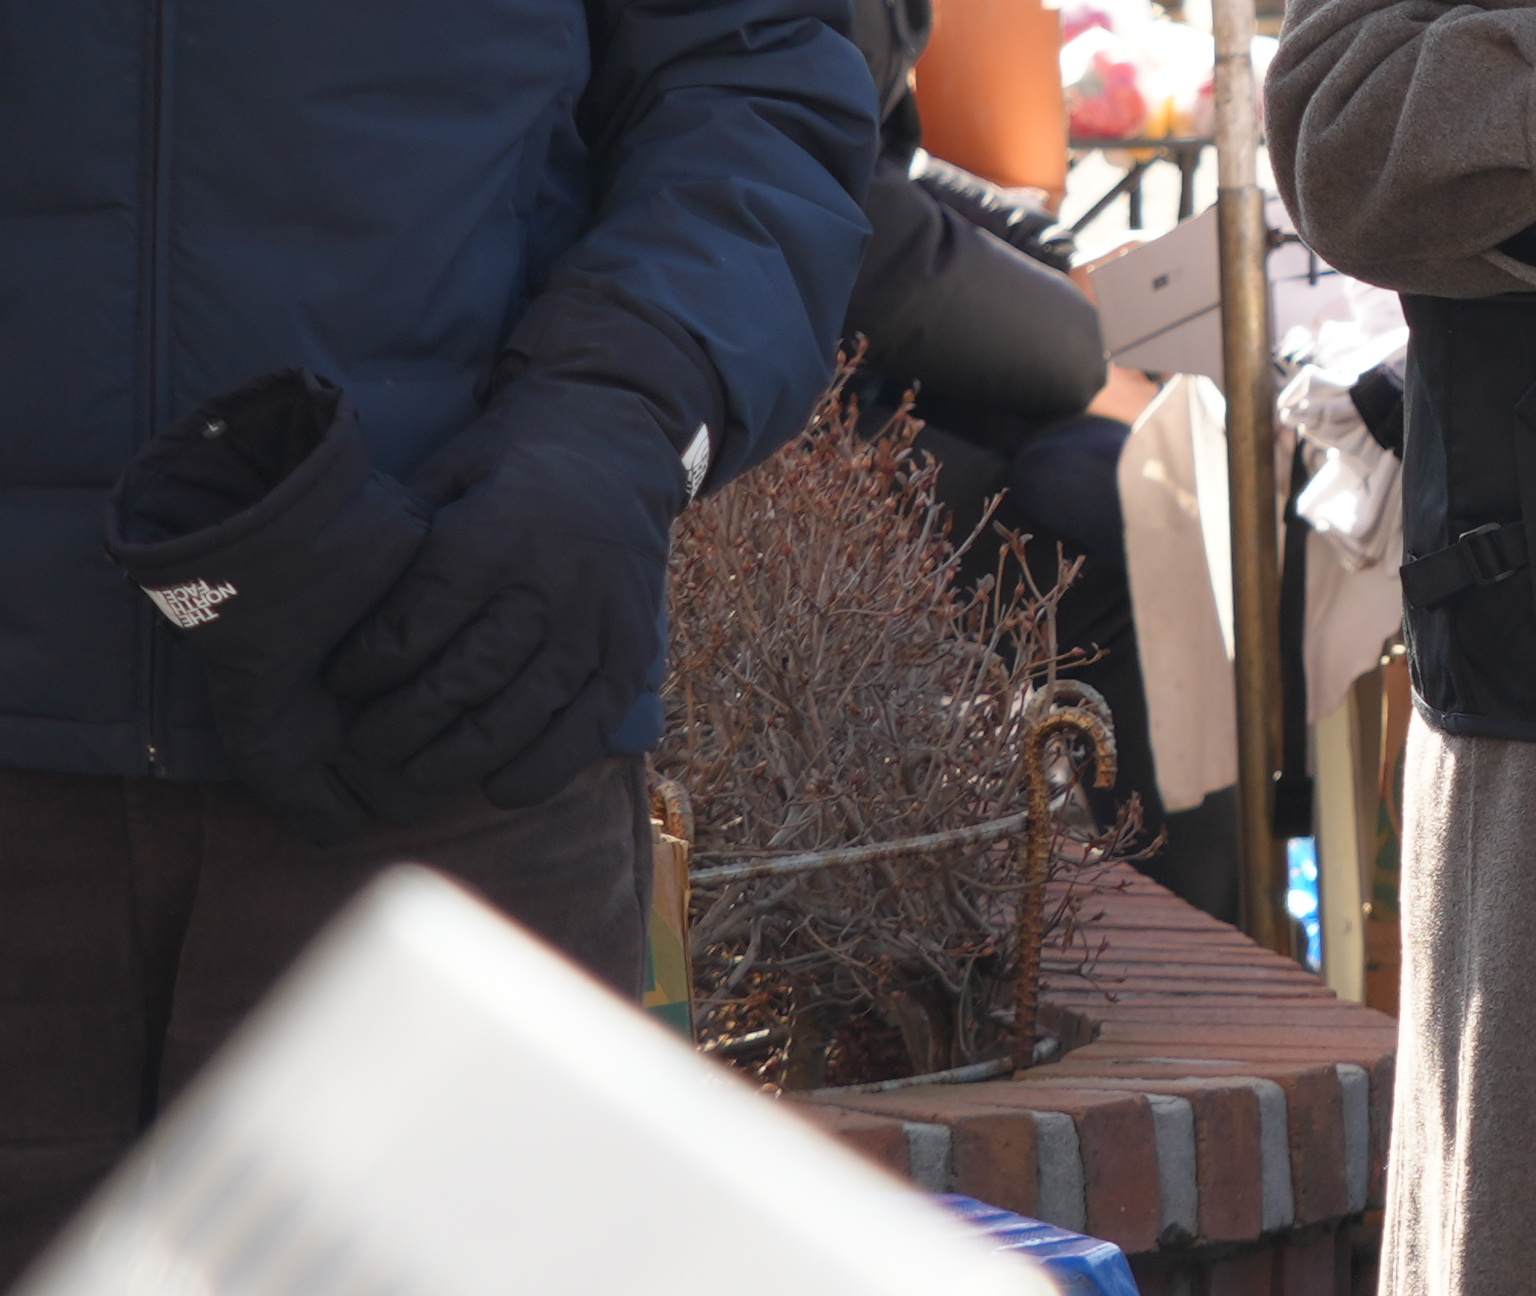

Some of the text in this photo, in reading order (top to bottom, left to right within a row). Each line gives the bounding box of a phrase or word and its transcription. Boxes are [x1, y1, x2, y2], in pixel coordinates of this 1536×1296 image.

[161, 578, 211, 604] FACE
[170, 580, 238, 616] NORTH
[178, 607, 220, 628] THE
